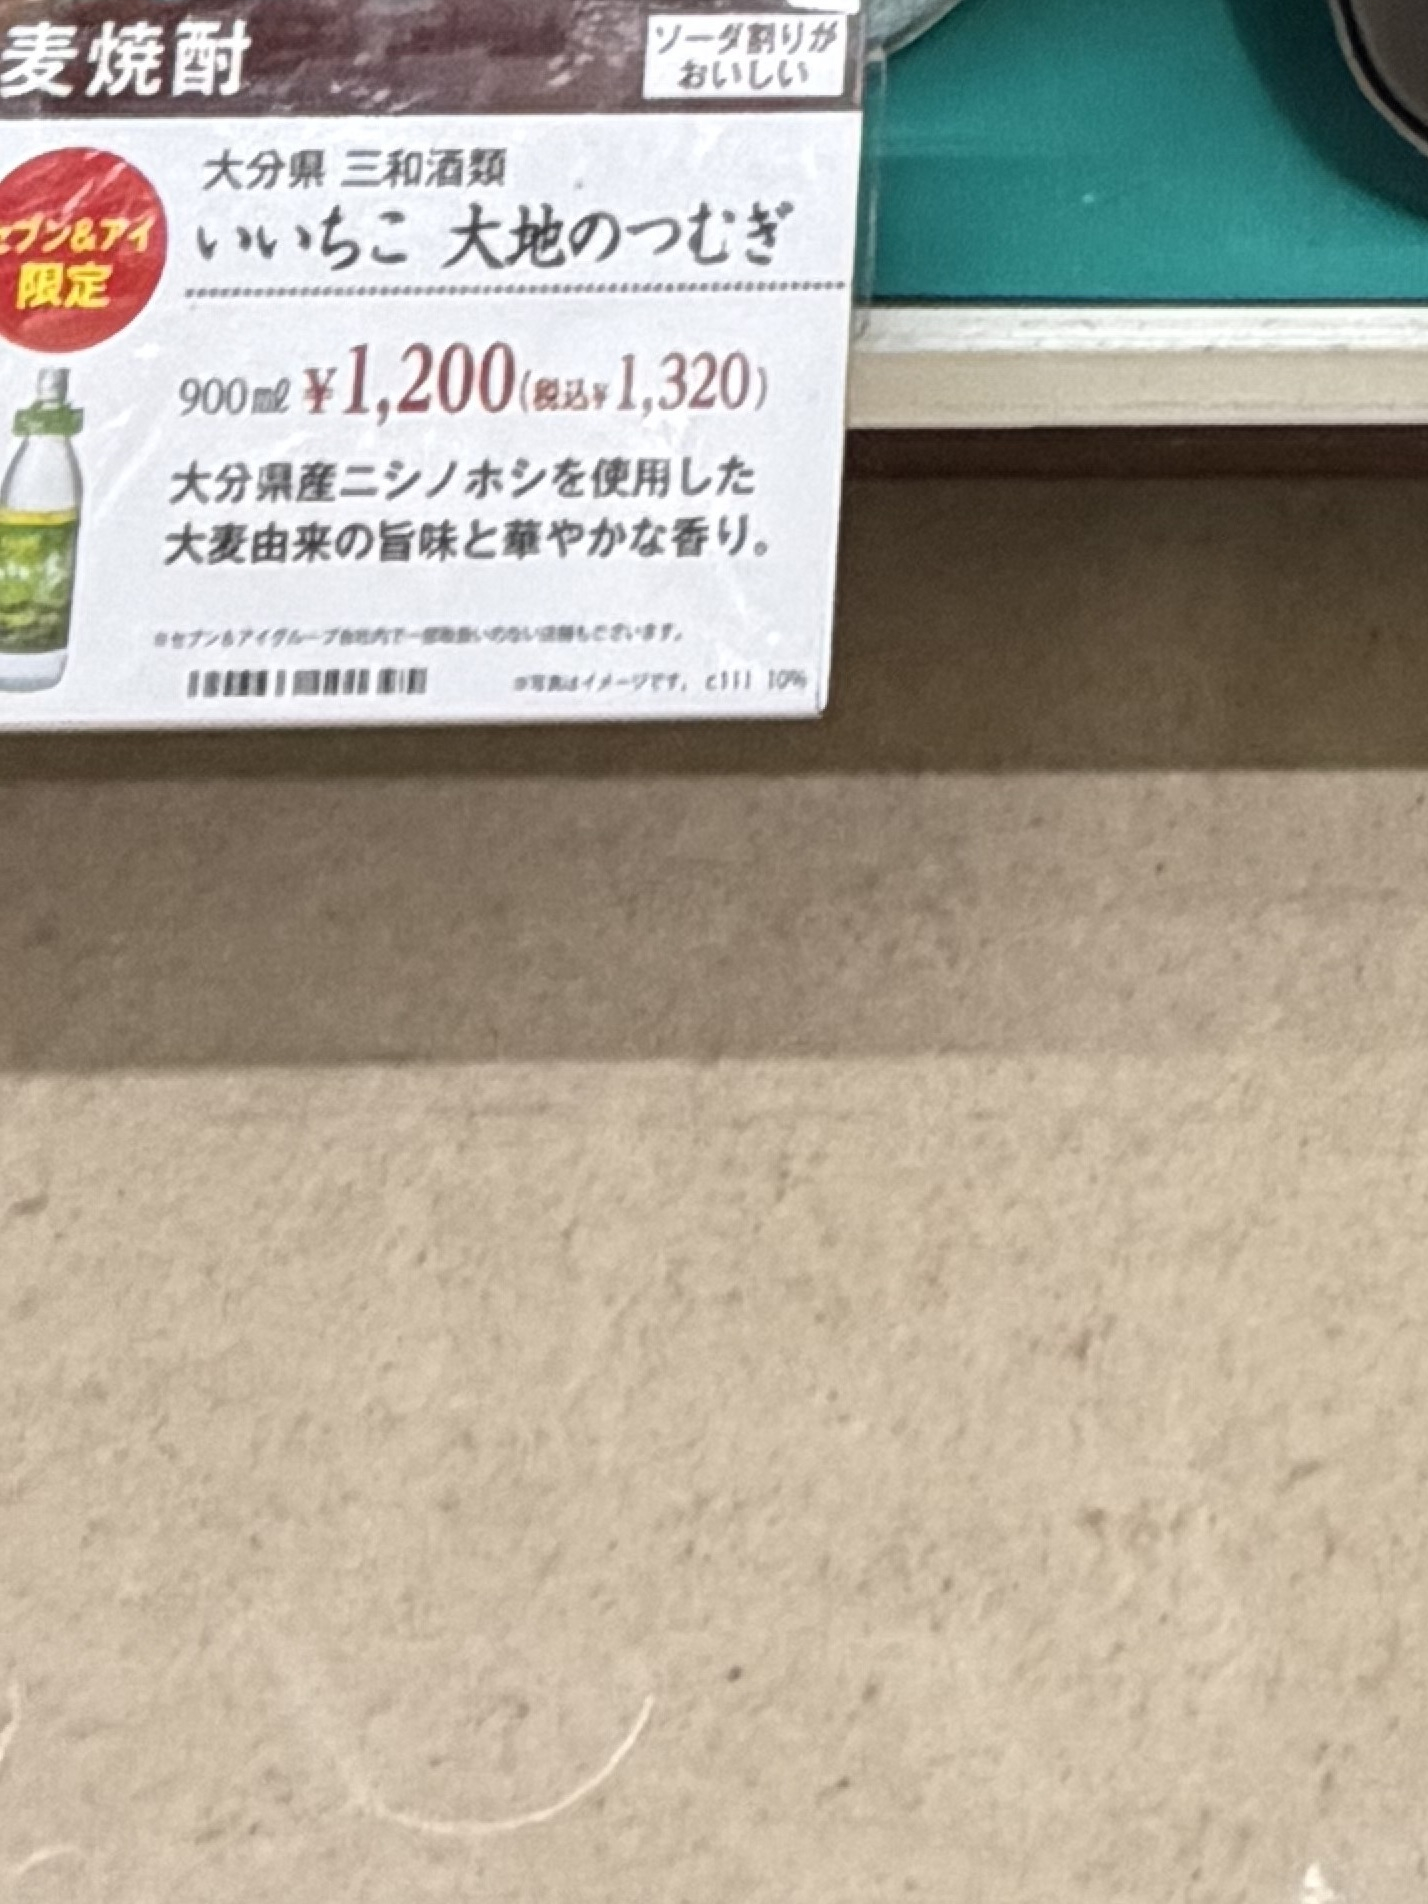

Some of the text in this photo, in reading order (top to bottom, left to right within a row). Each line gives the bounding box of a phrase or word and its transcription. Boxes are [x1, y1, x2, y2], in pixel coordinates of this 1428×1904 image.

[0, 17, 839, 99] 麦焼酎 ソーダ割りが
[676, 58, 810, 91] おいしい
[202, 147, 508, 191] 大分県 三和酒類
[196, 200, 796, 272] いいちこ 大地のつむぎ
[14, 261, 112, 311] 限定
[170, 454, 757, 505] 大分県産ニシノホシを使用した
[164, 513, 772, 568] 大麦由来の旨味と華やかな香り。
